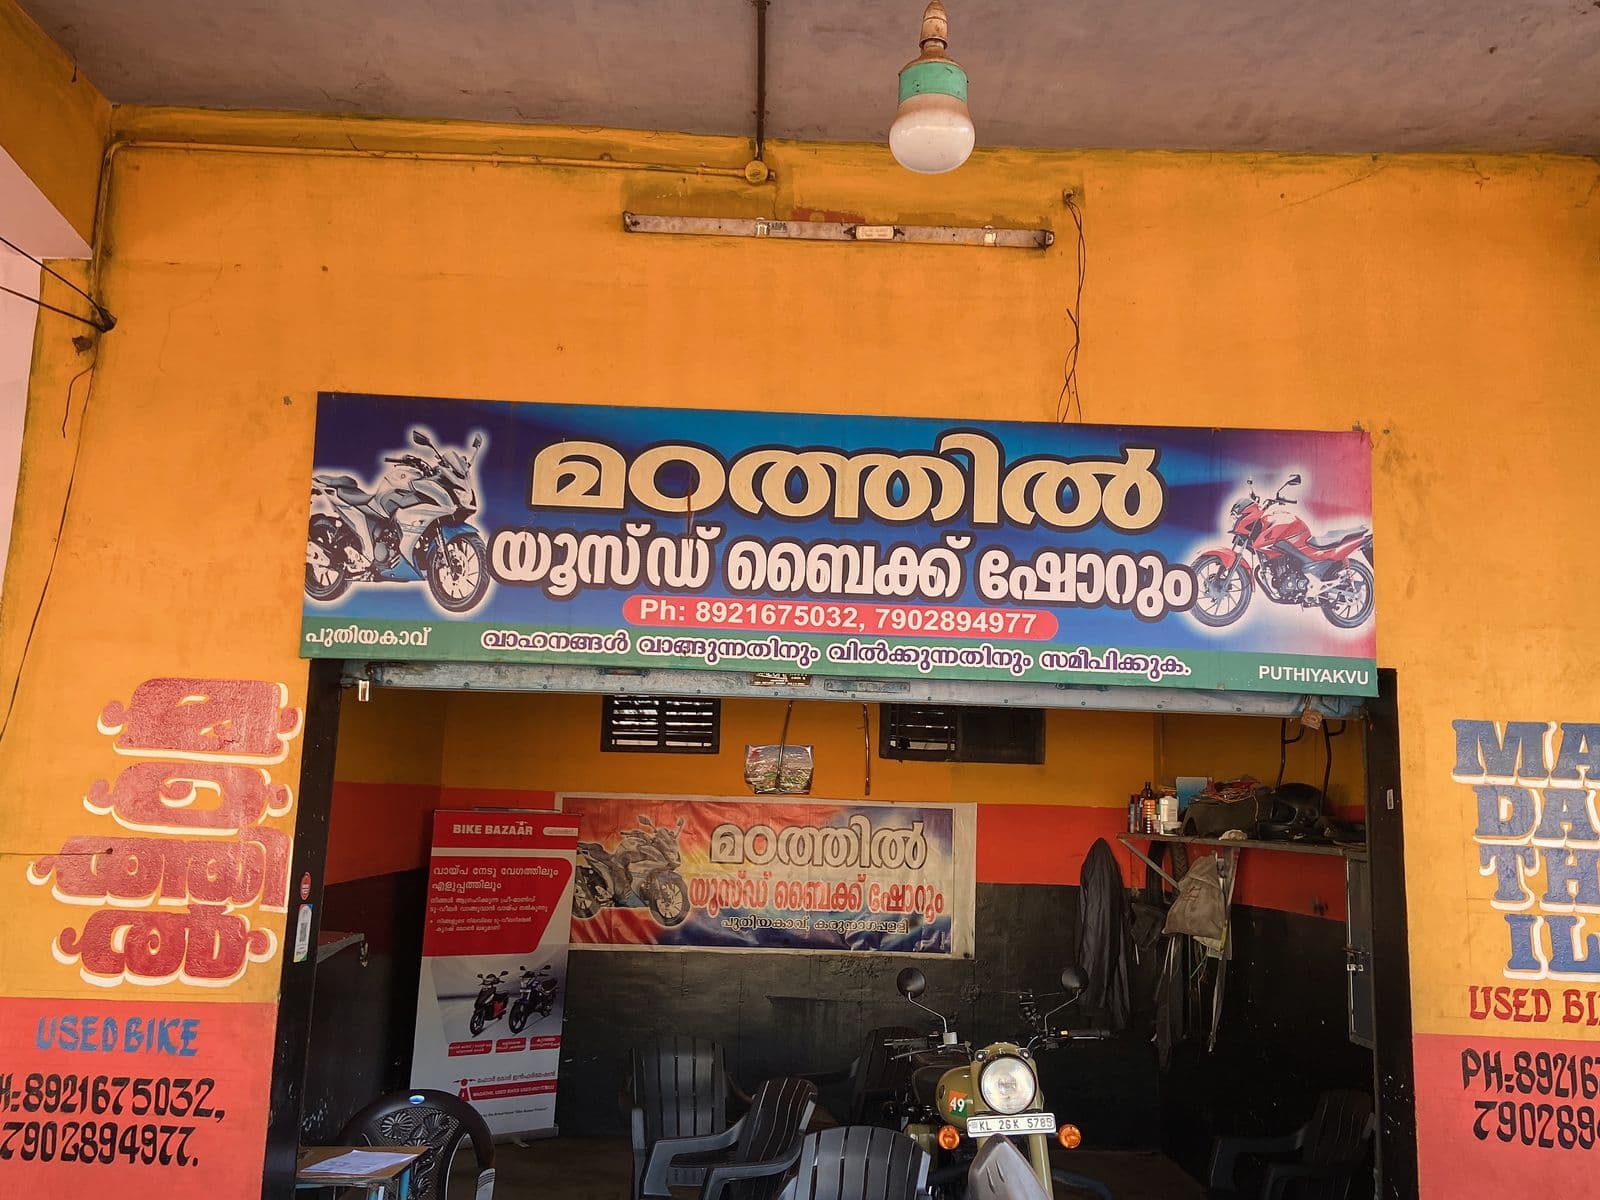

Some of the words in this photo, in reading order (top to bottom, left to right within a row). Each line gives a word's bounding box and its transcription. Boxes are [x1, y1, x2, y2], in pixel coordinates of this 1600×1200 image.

[531, 432, 1164, 531] മഠത്തിൽ
[727, 535, 971, 598] ബൈക്ക്
[979, 549, 1192, 618] ഷോറും
[640, 599, 685, 621] Ph:
[694, 601, 866, 633] 8921675032,
[875, 608, 1038, 634] 7902894977
[304, 624, 432, 648] പുതിയകാവ്
[480, 629, 630, 655] വാഹനങ്ങൾ
[1257, 664, 1370, 686] PUTHIYAKVU
[453, 824, 482, 834] BIKE
[484, 824, 533, 836] BAZAAR
[709, 814, 928, 872] മഠത്തിൽ
[774, 873, 867, 912] ബൈക്ക്
[1469, 984, 1552, 1023] USED
[1562, 988, 1600, 1027] BI
[35, 1015, 118, 1054] USED
[122, 1018, 201, 1057] BIKE
[949, 1095, 966, 1113] 49
[978, 1120, 992, 1131] KL
[1472, 1099, 1600, 1150] 790289
